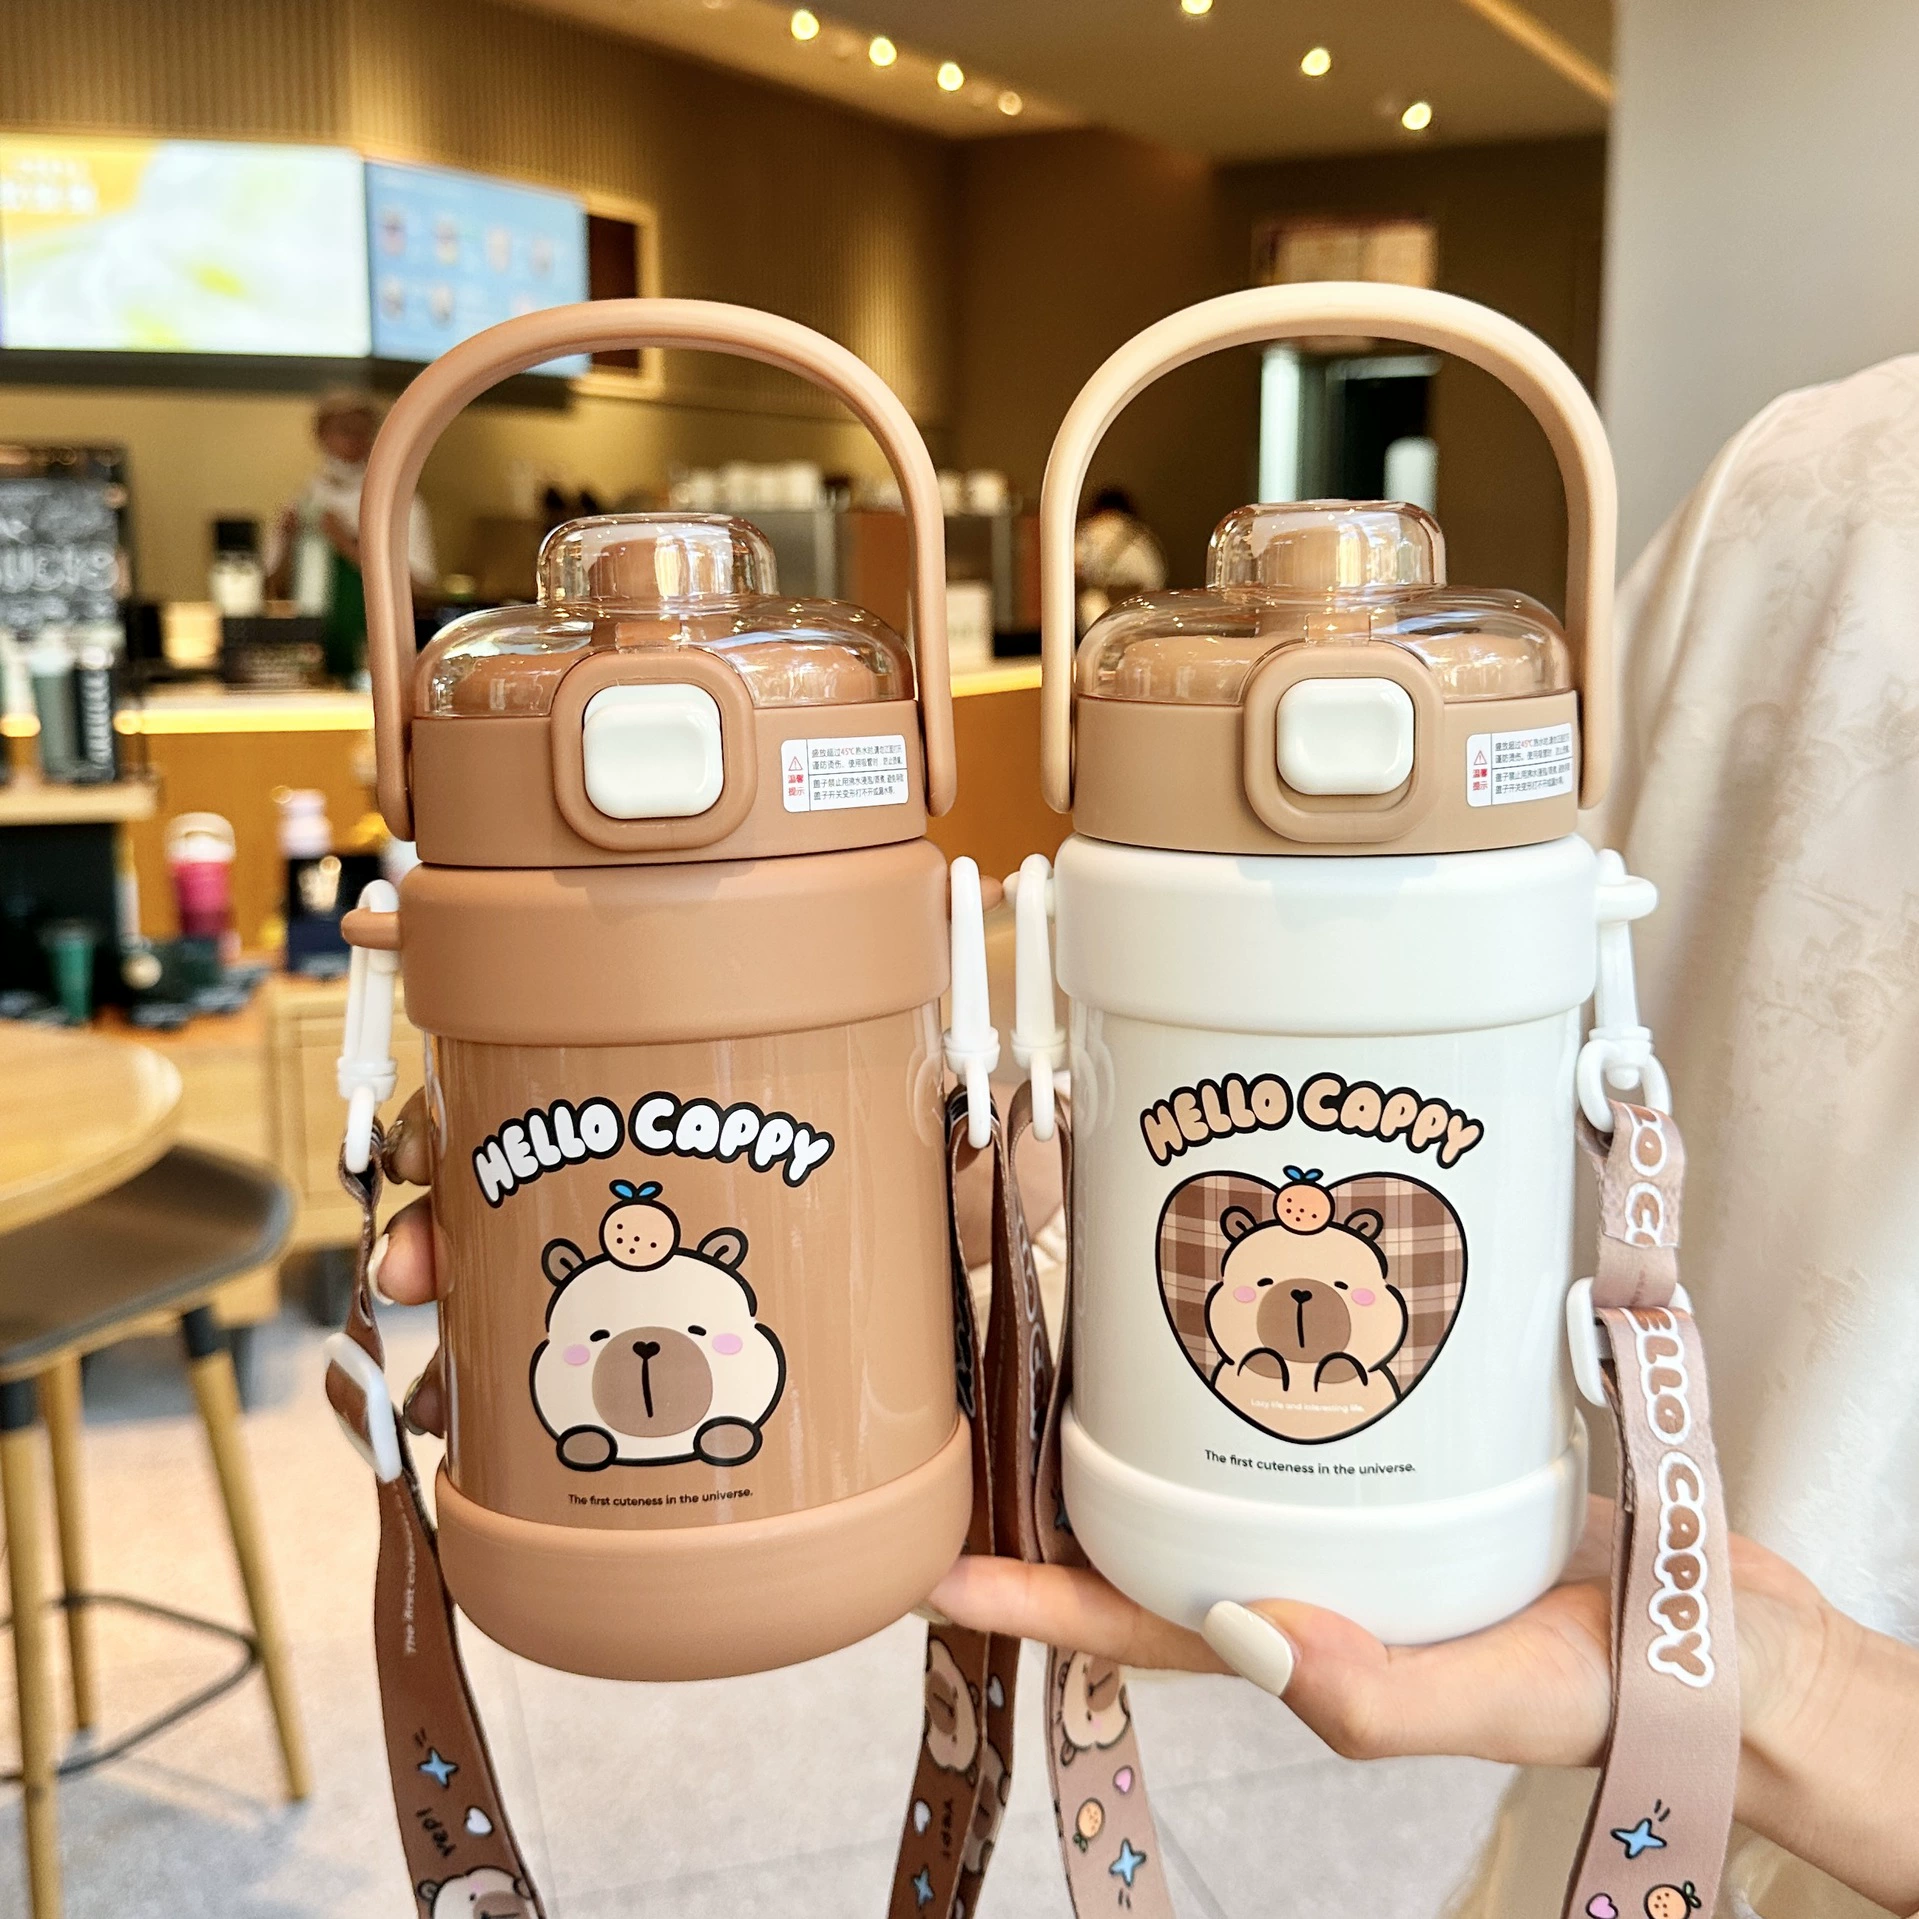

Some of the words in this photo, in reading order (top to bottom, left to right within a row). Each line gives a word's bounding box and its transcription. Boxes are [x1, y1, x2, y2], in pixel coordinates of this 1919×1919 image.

[1140, 1073, 1293, 1167] HELLO
[473, 1097, 625, 1208] HELLO
[1205, 1449, 1227, 1463] The
[1230, 1454, 1253, 1468] first
[1256, 1459, 1315, 1474] cuteness
[1318, 1463, 1330, 1475] in
[1333, 1463, 1356, 1475] the
[1359, 1462, 1416, 1475] universe.
[568, 1494, 588, 1505] The
[590, 1495, 611, 1506] first
[613, 1495, 664, 1507] cuteness
[666, 1494, 677, 1505] in
[680, 1492, 699, 1504] the
[701, 1487, 754, 1503] universe.
